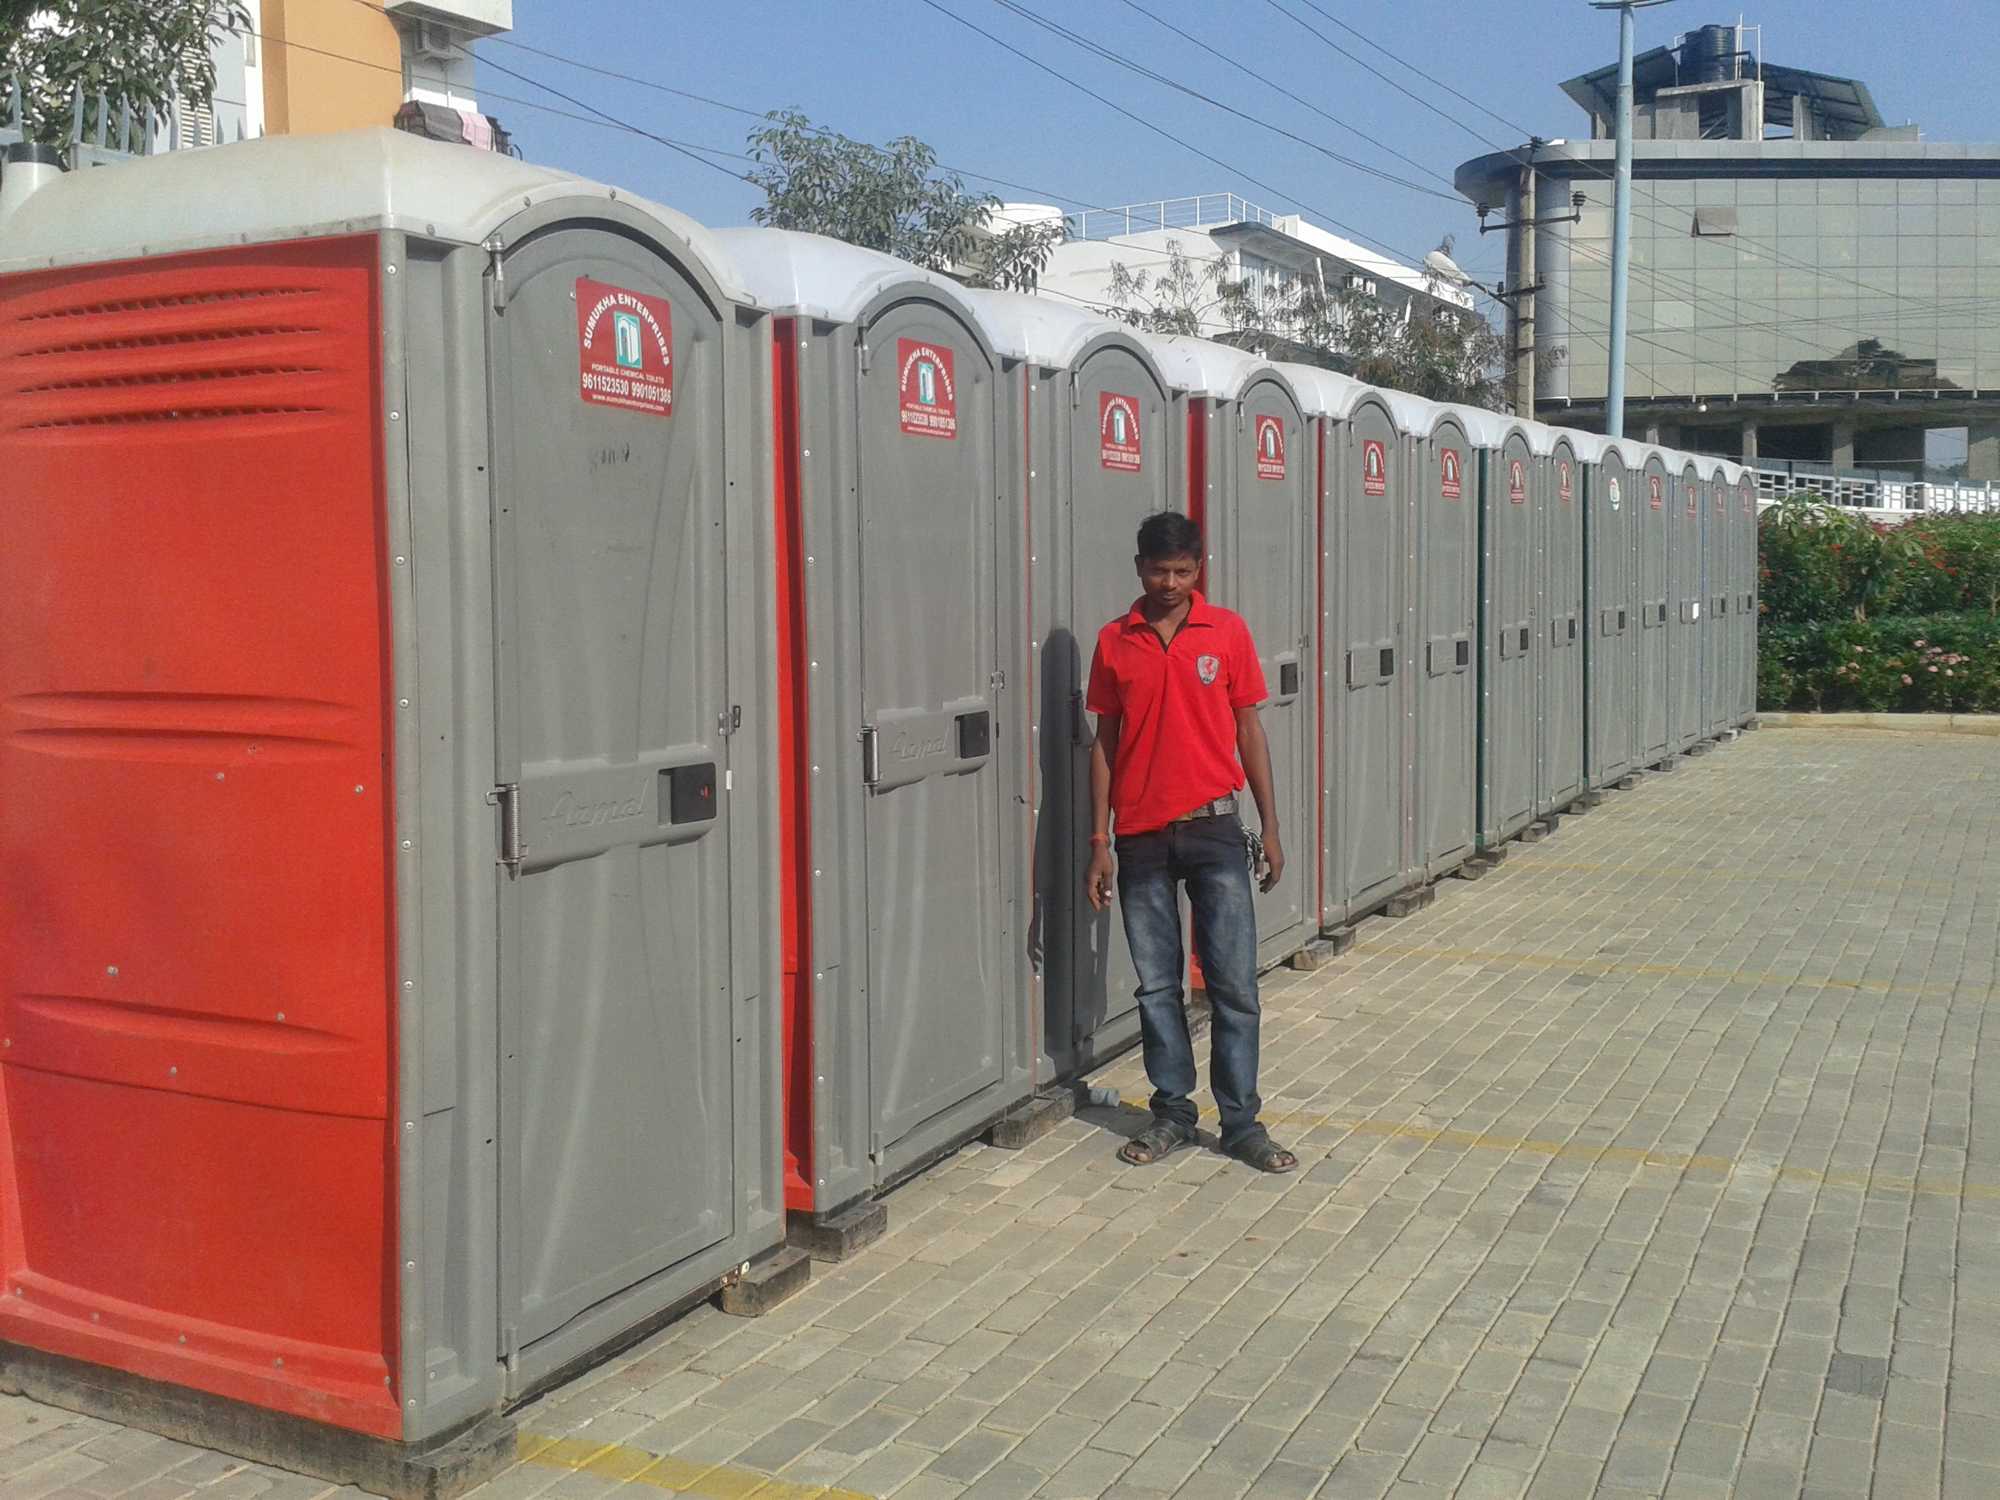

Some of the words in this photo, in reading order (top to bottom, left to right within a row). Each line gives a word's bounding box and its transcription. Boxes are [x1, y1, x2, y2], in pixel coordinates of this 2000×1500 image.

[583, 295, 617, 350] SUMUKHA
[617, 293, 670, 367] ENTERPRISES
[582, 372, 629, 395] 9611523530
